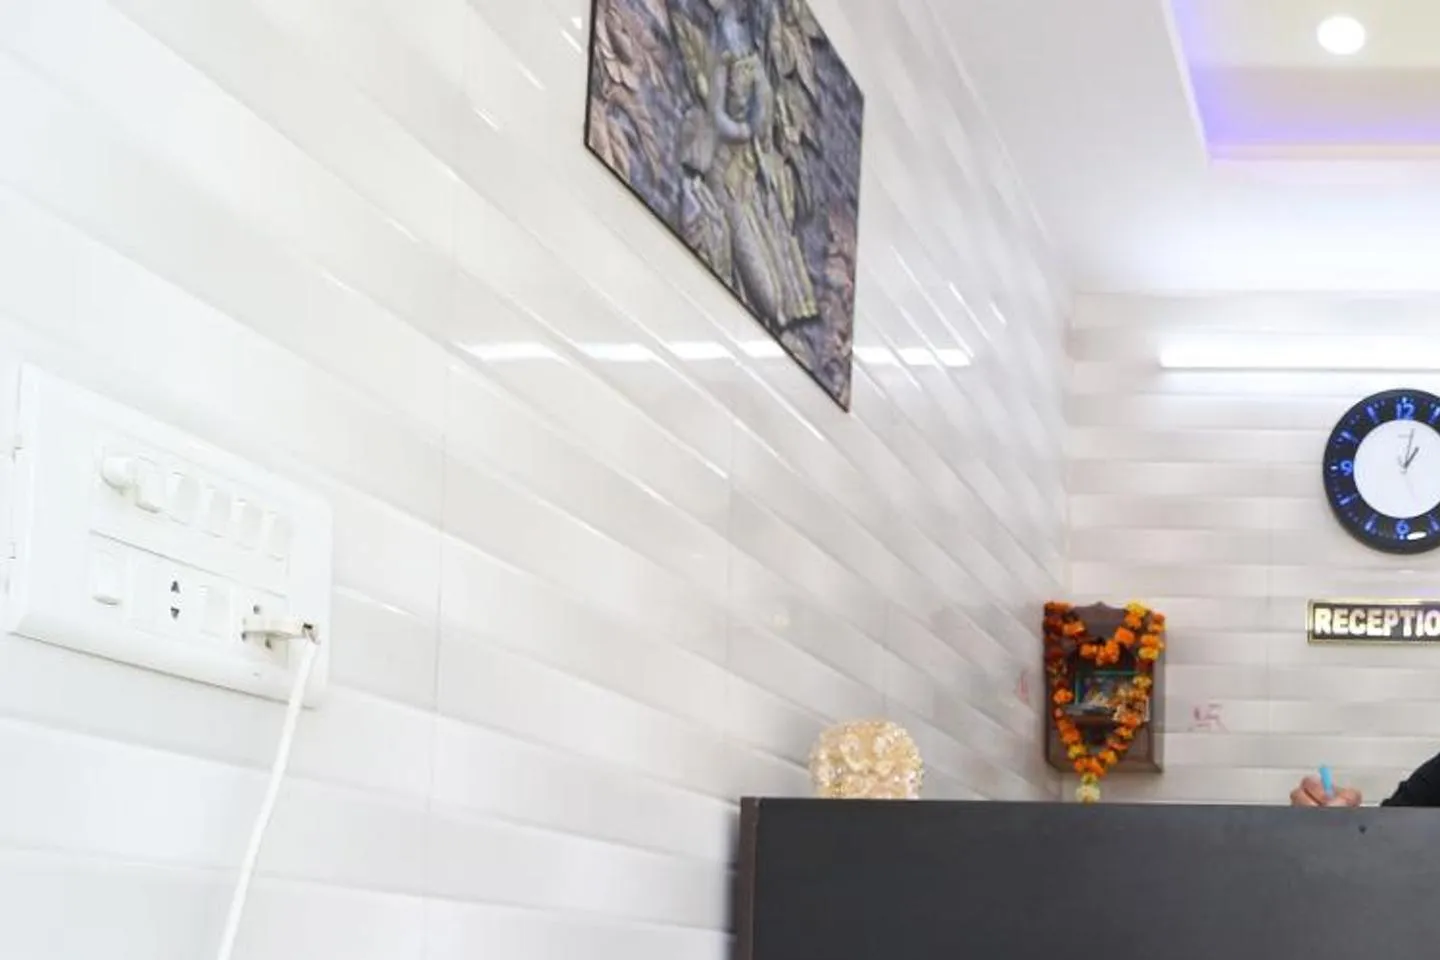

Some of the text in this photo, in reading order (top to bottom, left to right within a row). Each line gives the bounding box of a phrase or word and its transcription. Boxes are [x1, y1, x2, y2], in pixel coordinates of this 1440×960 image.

[1396, 402, 1416, 420] 12
[1340, 460, 1353, 476] 9
[1396, 519, 1410, 534] 6
